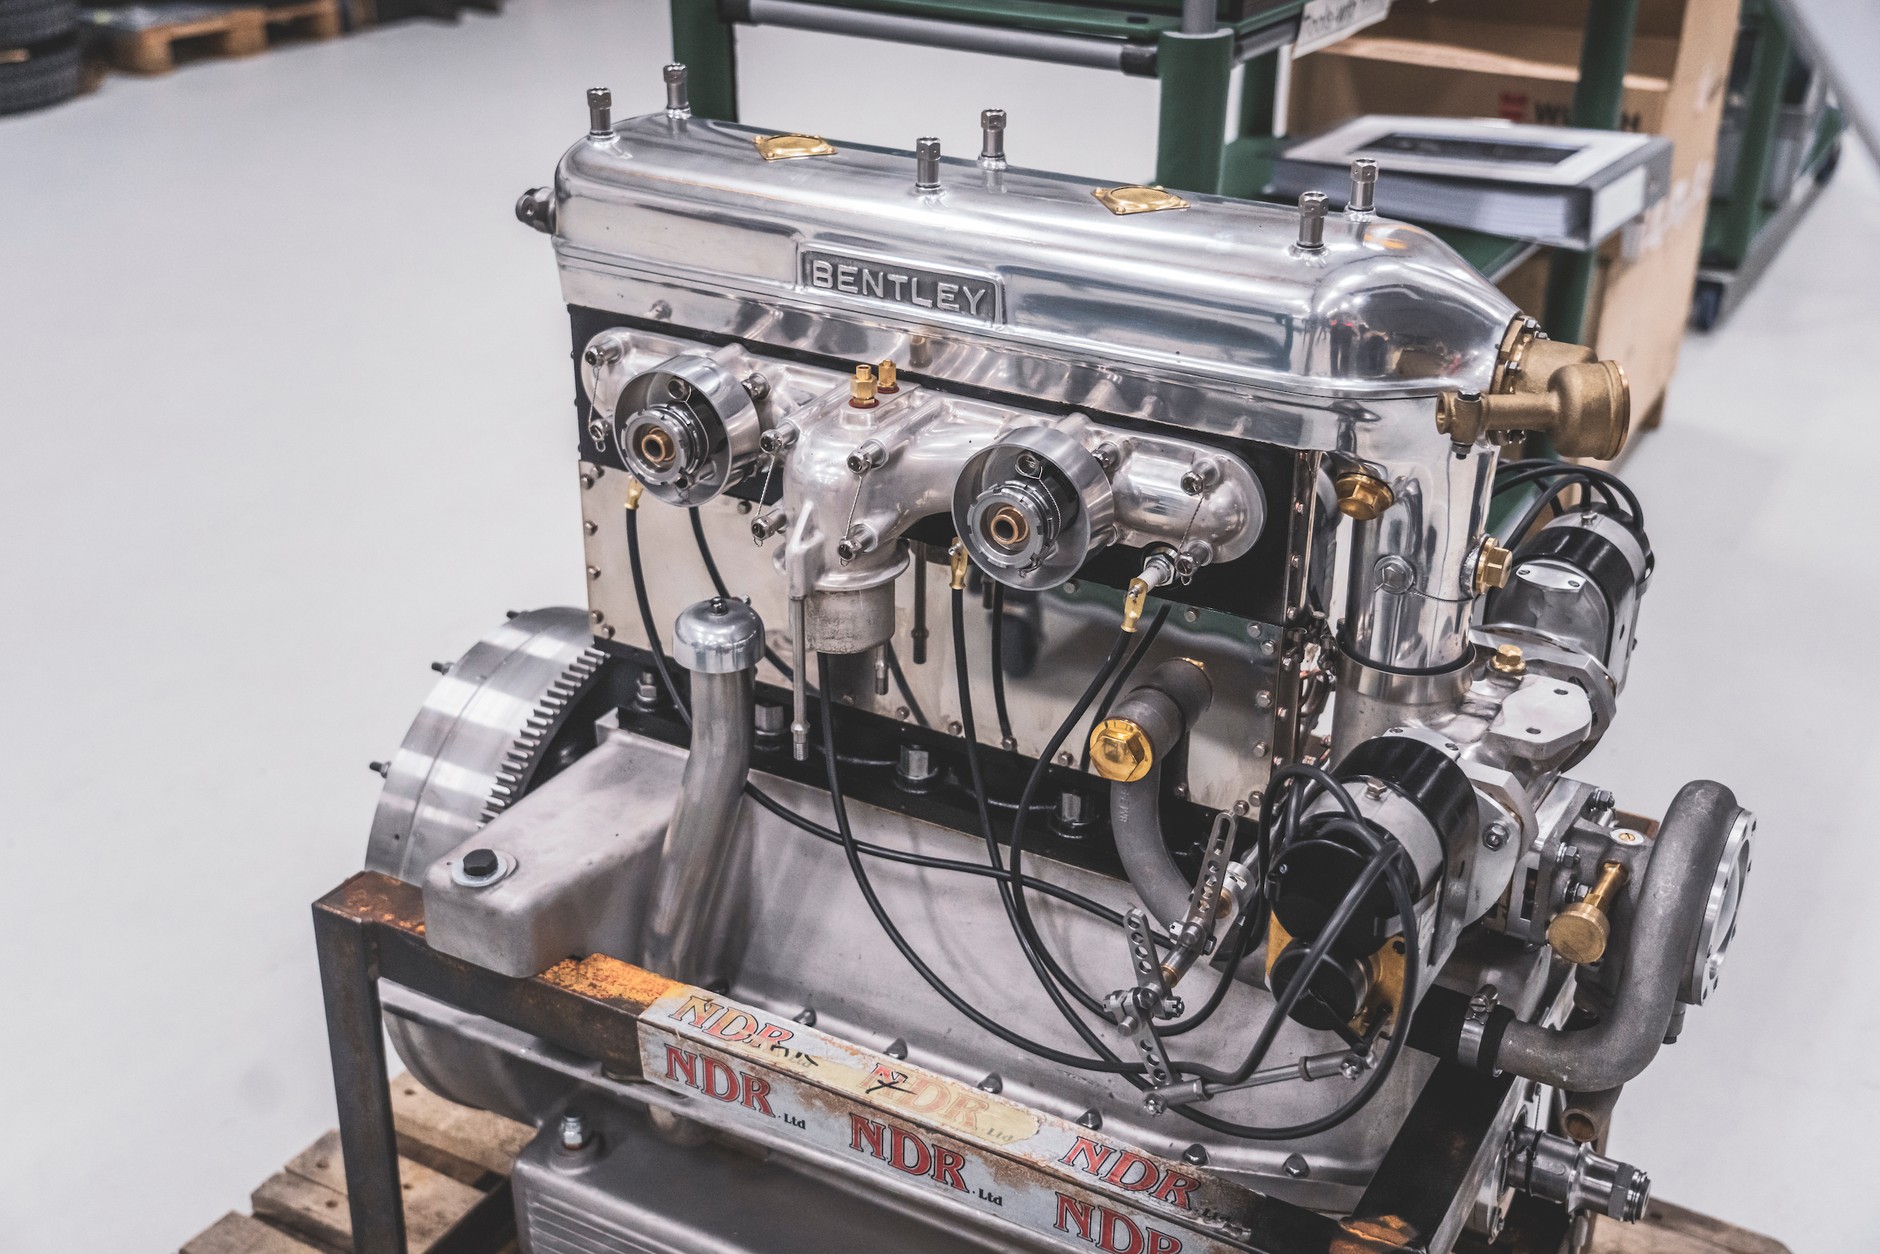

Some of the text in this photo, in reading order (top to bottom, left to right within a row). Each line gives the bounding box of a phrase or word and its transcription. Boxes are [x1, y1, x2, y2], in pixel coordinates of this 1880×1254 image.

[812, 259, 987, 316] BENTLEY
[784, 1112, 807, 1130] Ltd
[986, 1126, 1014, 1142] Ltd
[978, 1187, 1004, 1207] Ltd
